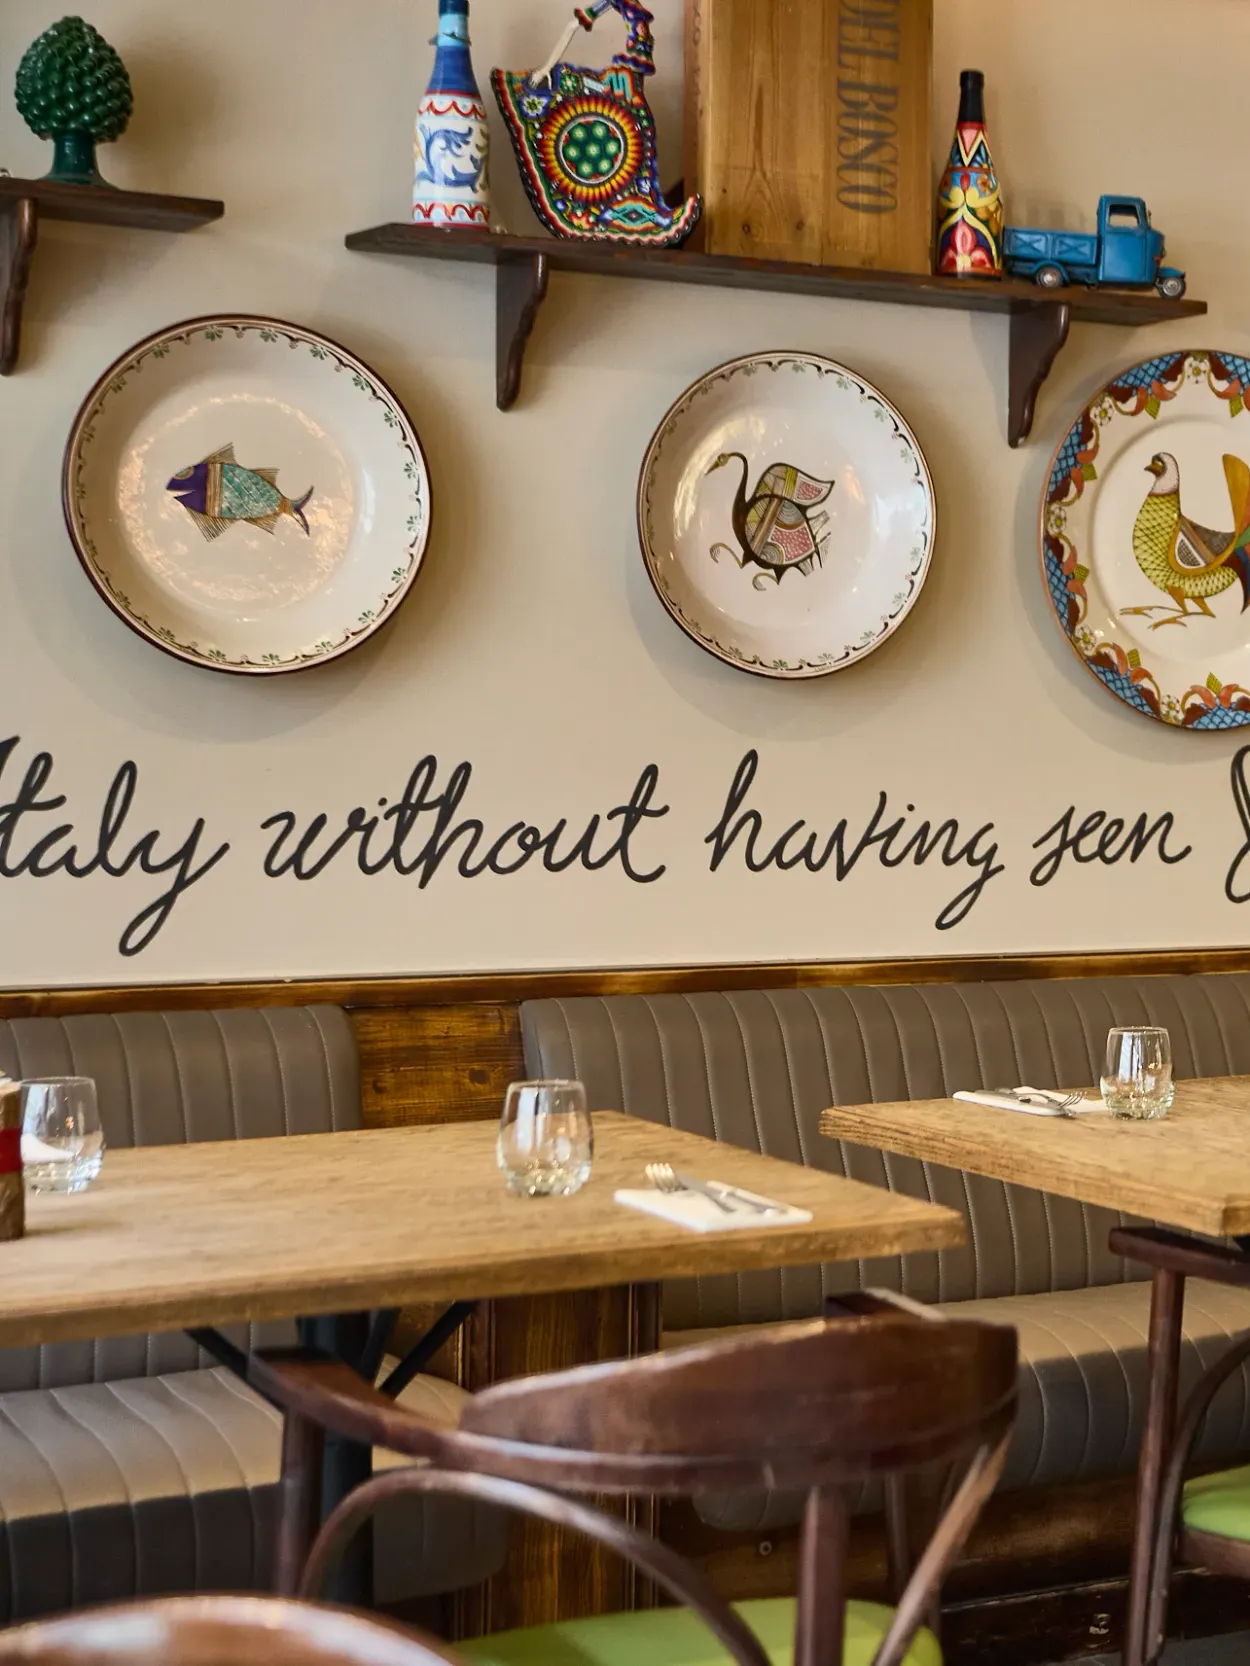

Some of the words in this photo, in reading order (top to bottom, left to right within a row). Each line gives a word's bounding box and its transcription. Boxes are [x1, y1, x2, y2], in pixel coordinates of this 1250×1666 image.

[836, 77, 899, 214] BOSCO
[0, 735, 231, 957] taly
[260, 754, 670, 890] without
[704, 748, 1005, 931] having
[1029, 805, 1192, 887] seen
